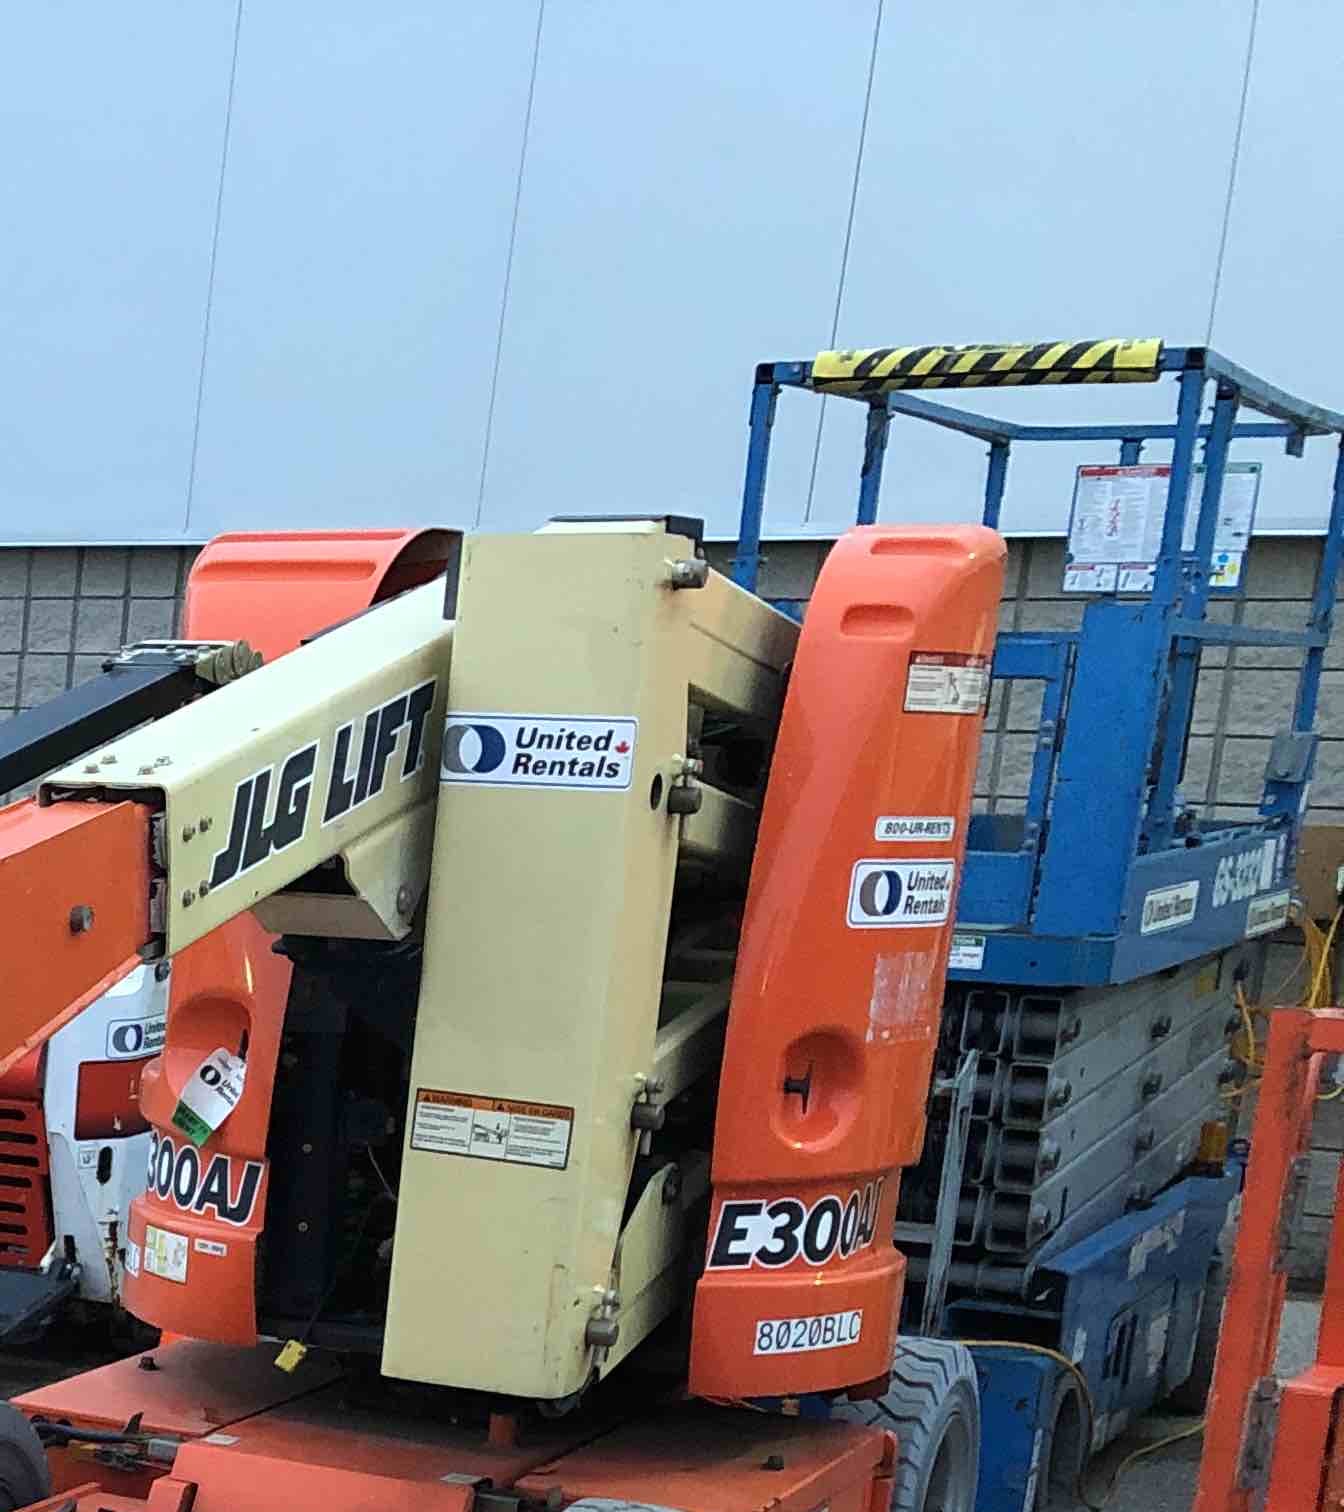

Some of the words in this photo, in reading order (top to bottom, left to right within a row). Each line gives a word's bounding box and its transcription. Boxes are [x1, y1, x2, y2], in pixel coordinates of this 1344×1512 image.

[515, 727, 614, 752] United
[512, 753, 620, 779] Rentals
[208, 739, 320, 892] JLG
[321, 678, 437, 826] LIFT
[907, 871, 947, 891] United
